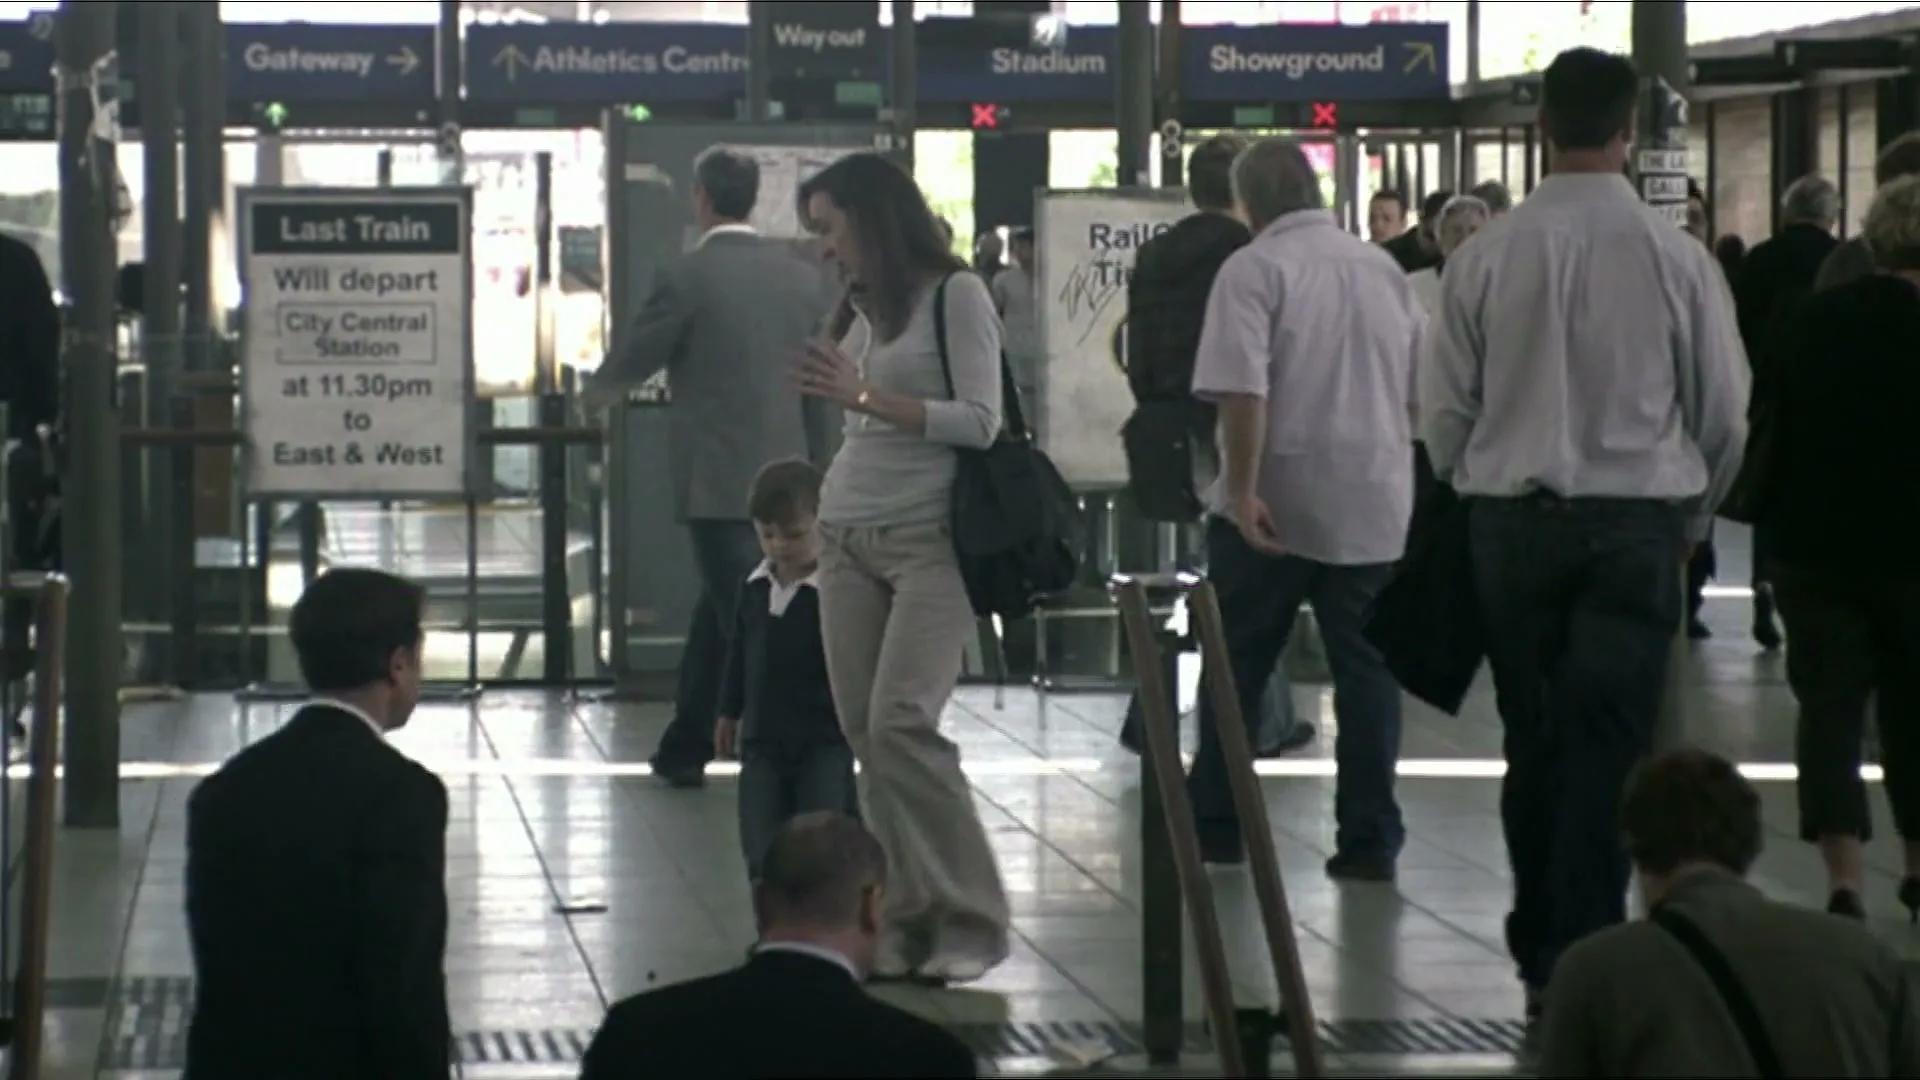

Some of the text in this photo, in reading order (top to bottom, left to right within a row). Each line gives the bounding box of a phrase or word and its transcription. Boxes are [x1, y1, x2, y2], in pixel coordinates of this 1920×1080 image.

[774, 23, 866, 52] Way out
[244, 42, 374, 78] Gateway
[533, 45, 658, 74] Athletics
[991, 47, 1106, 74] Stadium
[1209, 44, 1385, 79] Showground
[280, 215, 431, 242] Last Train
[273, 267, 438, 296] Will depart
[285, 312, 427, 335] City Central
[315, 336, 400, 357] Station
[282, 373, 433, 401] at 11.30pm
[344, 410, 372, 431] to
[272, 442, 445, 466] East & West
